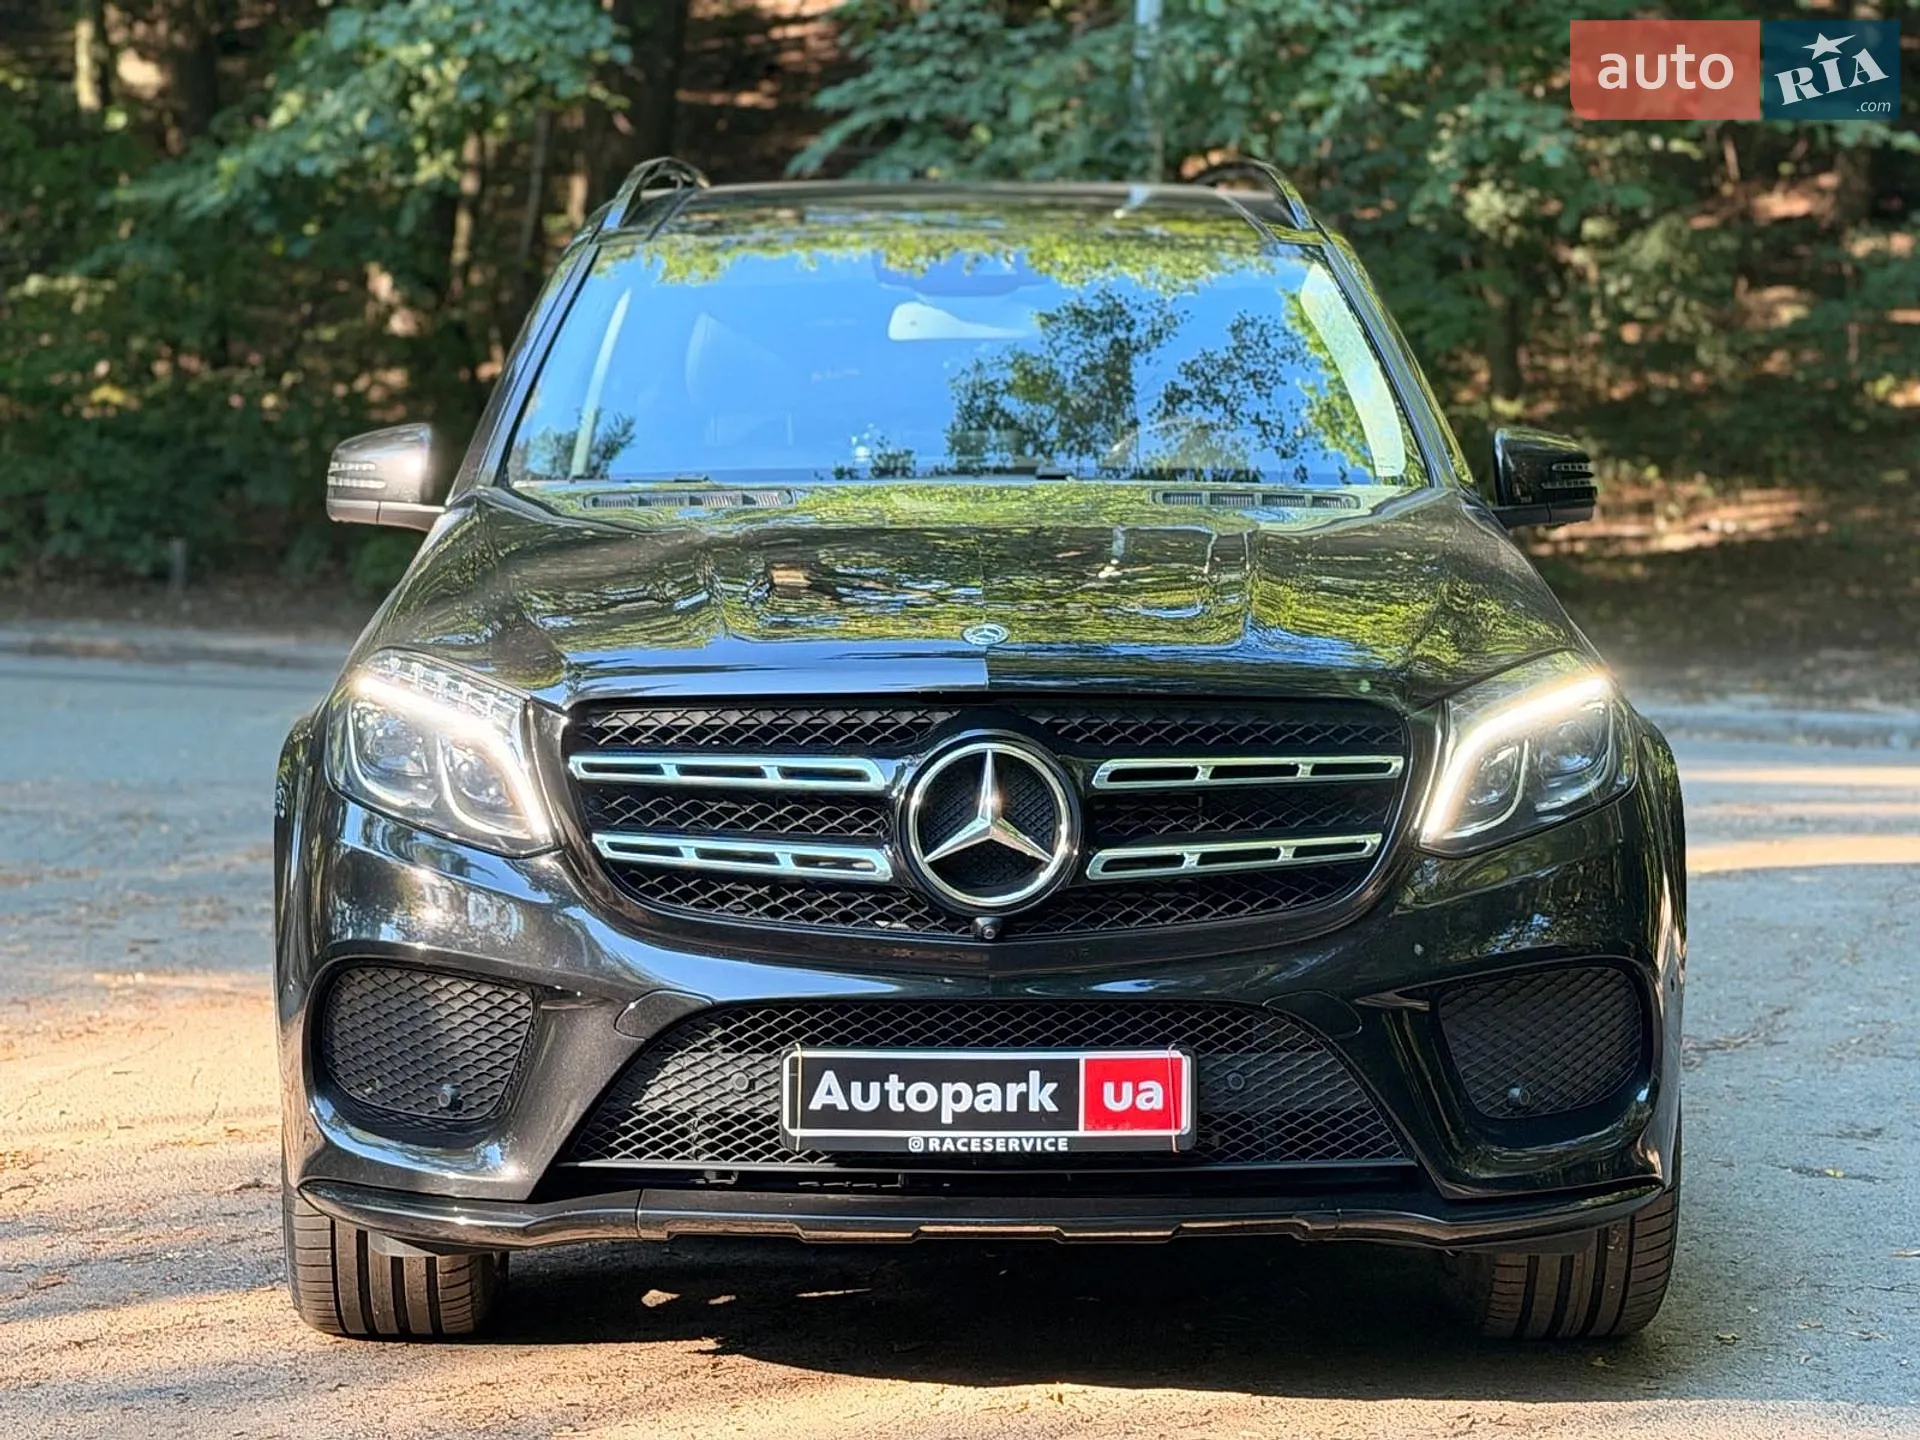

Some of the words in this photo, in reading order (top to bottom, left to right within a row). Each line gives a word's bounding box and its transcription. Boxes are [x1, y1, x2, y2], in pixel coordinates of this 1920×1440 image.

[808, 1070, 1059, 1124] Autopark
[1103, 1080, 1163, 1110] ua
[928, 1137, 1068, 1152] RACESERVICE
